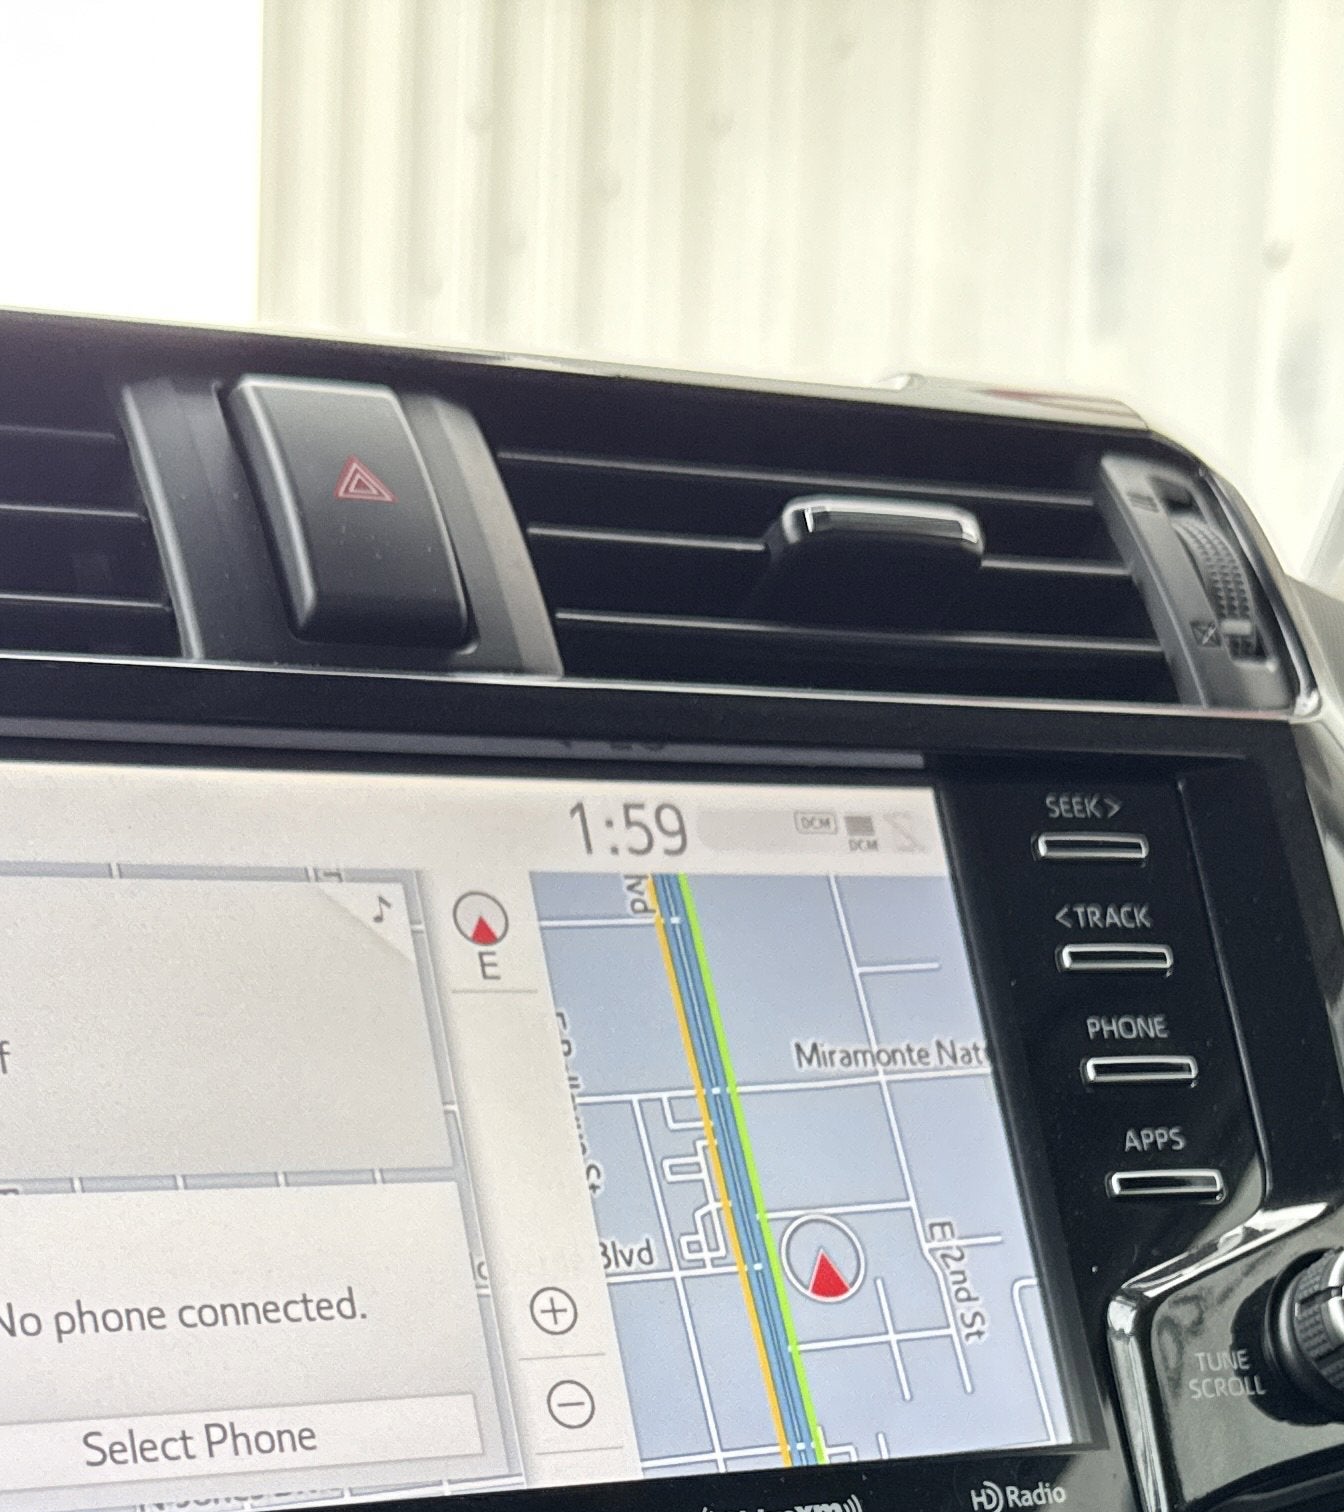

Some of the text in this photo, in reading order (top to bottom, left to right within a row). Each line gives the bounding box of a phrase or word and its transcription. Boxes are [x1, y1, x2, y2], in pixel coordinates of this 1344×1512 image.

[1045, 796, 1102, 819] SEEK
[569, 802, 689, 857] 1:59
[1074, 905, 1152, 929] TRACK
[478, 951, 501, 981] E
[1086, 1016, 1169, 1040] PHONE
[794, 1039, 987, 1068] Miramonte Nat
[1123, 1127, 1186, 1152] APPS
[928, 1220, 987, 1342] E 2nd St
[55, 1299, 168, 1343] phone
[178, 1286, 369, 1329] connected.
[1194, 1349, 1251, 1373] TUNE
[1188, 1376, 1266, 1400] SCROLL
[82, 1421, 318, 1468] Select Phone
[1006, 1482, 1067, 1508] Radio
